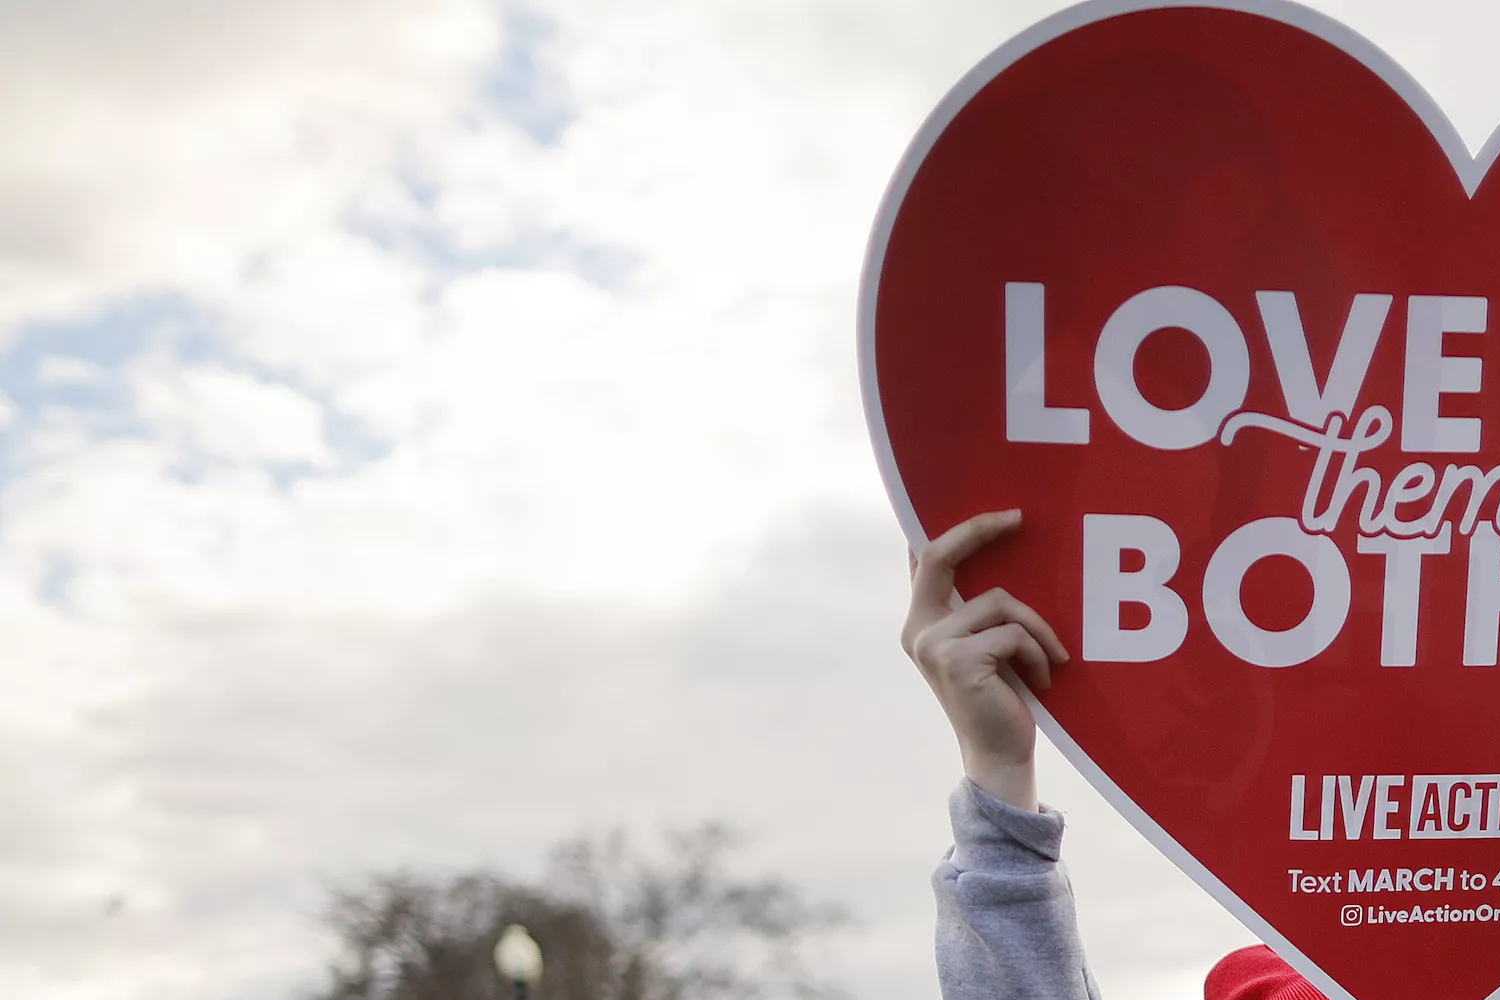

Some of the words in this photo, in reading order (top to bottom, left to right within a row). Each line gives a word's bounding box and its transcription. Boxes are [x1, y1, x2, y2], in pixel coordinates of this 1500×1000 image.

[1004, 281, 1488, 452] LOVE
[1289, 775, 1405, 840] LIVE
[1288, 869, 1342, 893] Text
[1347, 868, 1455, 892] MARCH
[1460, 871, 1487, 891] to
